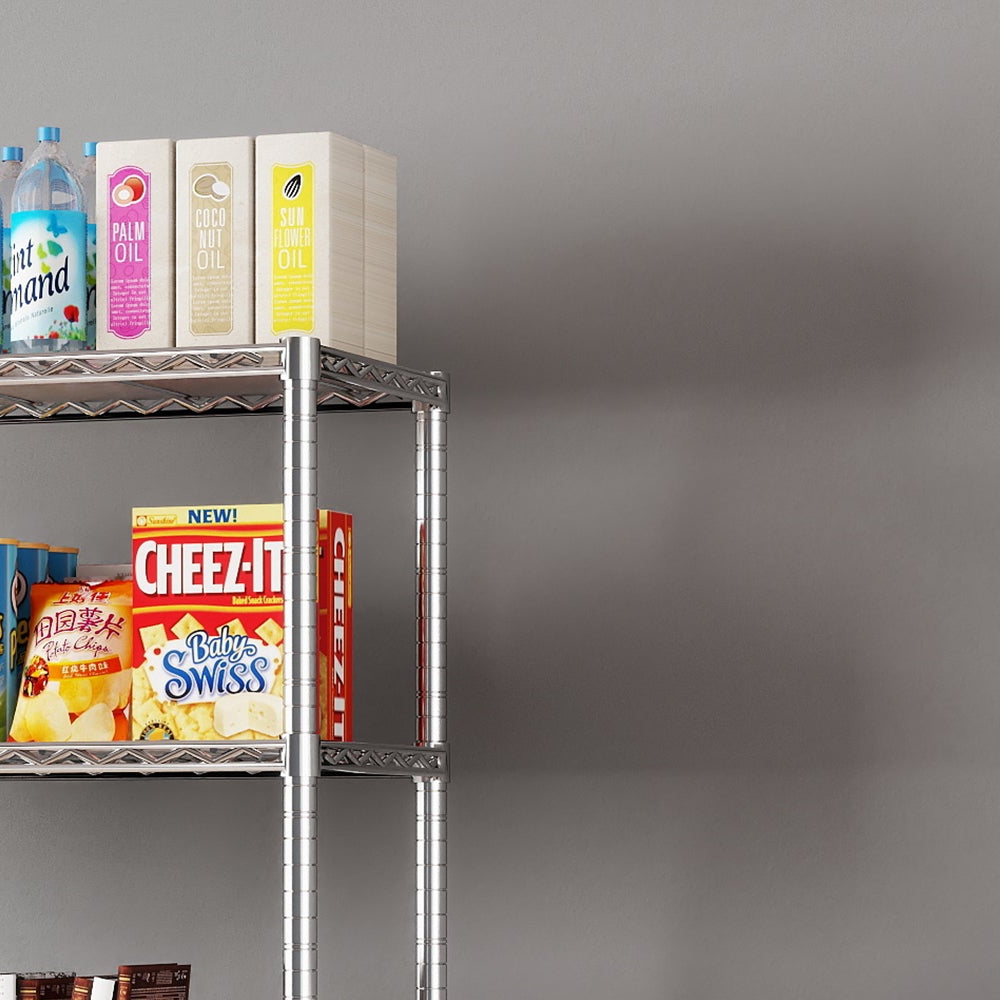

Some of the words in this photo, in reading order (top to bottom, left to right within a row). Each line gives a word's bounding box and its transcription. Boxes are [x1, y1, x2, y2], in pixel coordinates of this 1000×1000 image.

[195, 207, 226, 228] COCO
[280, 208, 304, 227] SUN
[112, 221, 146, 242] PALM
[199, 229, 223, 248] NUT
[274, 228, 311, 248] FLOWER
[114, 243, 144, 263] OIL
[197, 250, 225, 269] OIL
[278, 250, 307, 269] OIL
[188, 508, 238, 524] NEW!
[135, 538, 284, 595] CHEEZ-IT
[232, 596, 248, 606] Baked
[33, 606, 125, 648] 田园薯片
[73, 635, 110, 658] Chips
[186, 625, 257, 664] Baby
